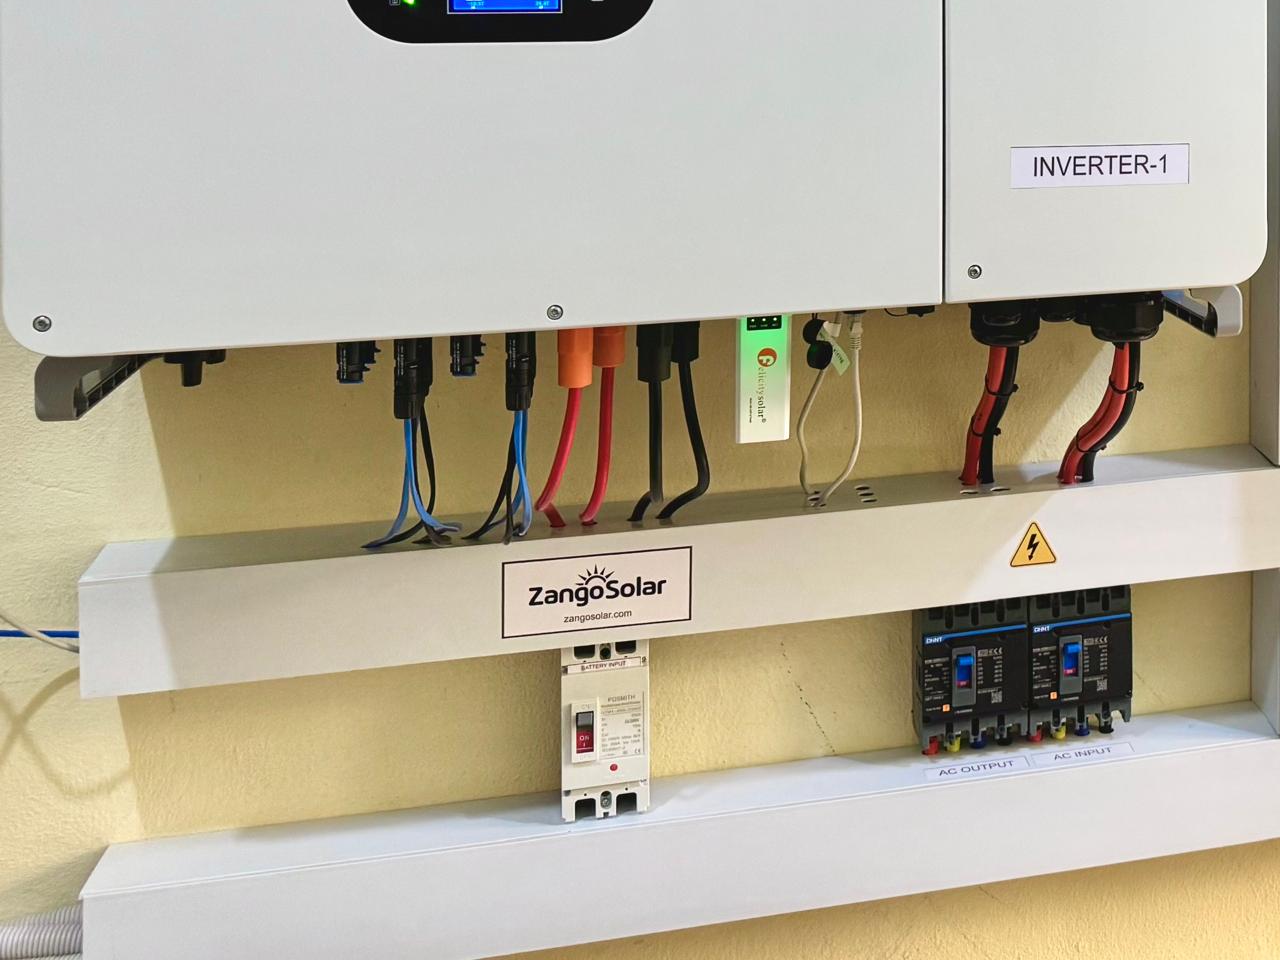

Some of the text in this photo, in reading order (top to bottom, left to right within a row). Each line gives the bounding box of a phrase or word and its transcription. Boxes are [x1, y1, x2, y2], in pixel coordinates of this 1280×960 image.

[1033, 154, 1167, 177] INVERTER-1
[528, 576, 667, 607] ZangoSolar
[563, 609, 632, 623] zangosolar.com
[581, 660, 626, 671] BATTERY INPUT
[1054, 746, 1112, 761] AC INPUT
[939, 760, 1015, 776] AC OUTPUT
